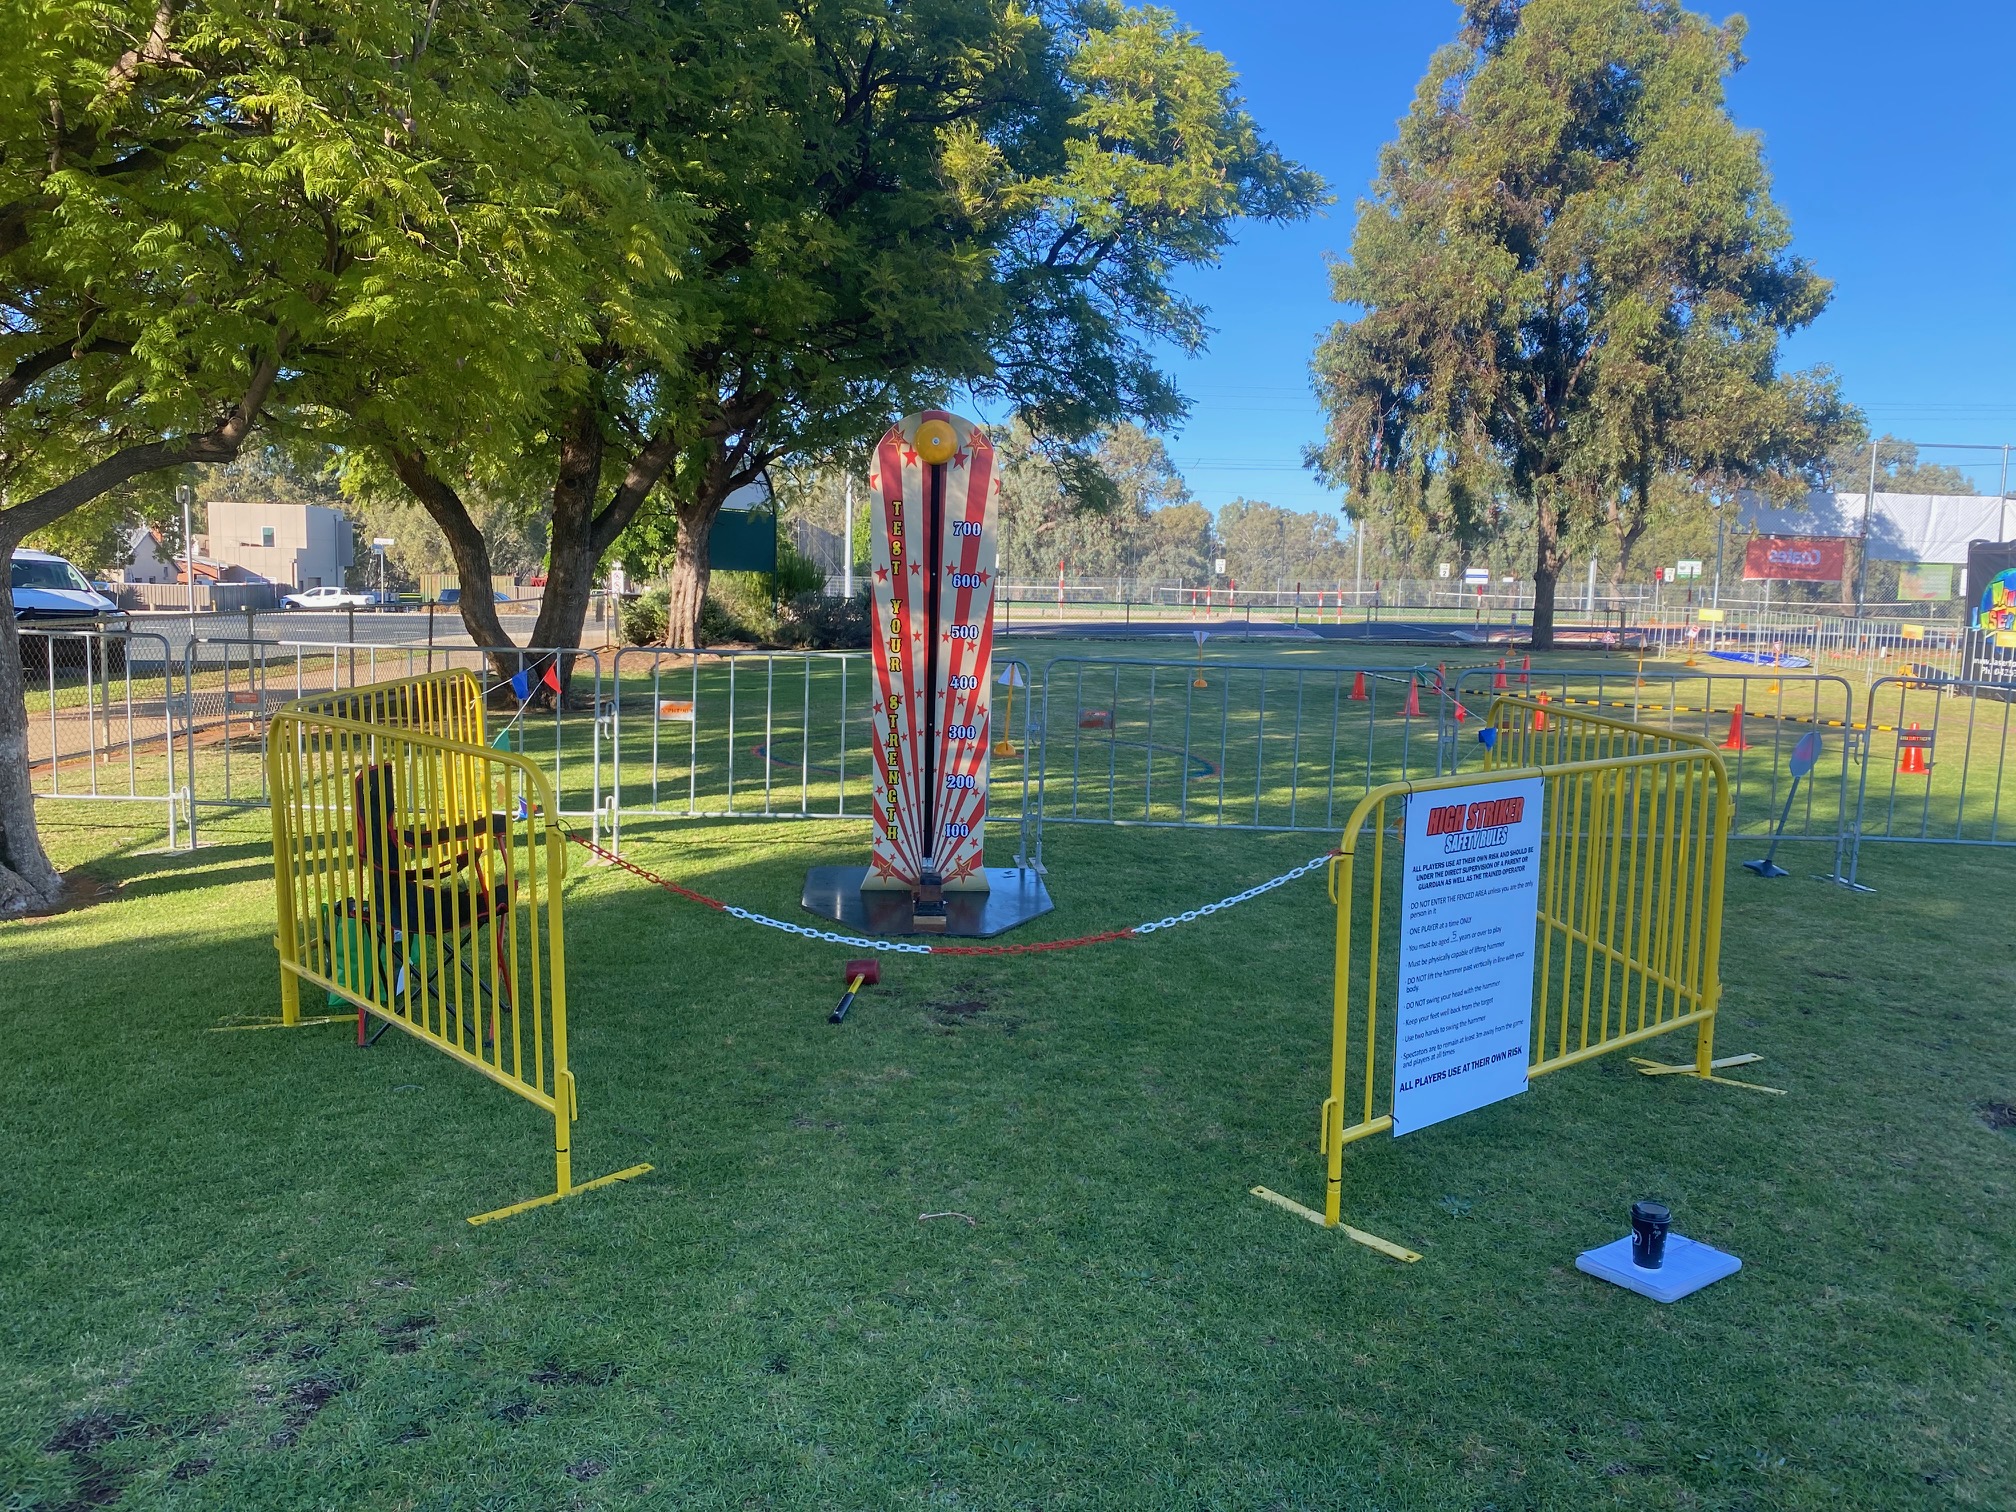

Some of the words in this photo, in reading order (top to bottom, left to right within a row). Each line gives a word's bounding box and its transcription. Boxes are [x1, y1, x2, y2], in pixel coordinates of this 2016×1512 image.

[953, 521, 982, 536] 700
[890, 501, 902, 575] TEST
[952, 574, 980, 588] 600
[890, 599, 902, 672] YOUR
[950, 625, 979, 639] 500
[950, 675, 978, 690] 400
[948, 725, 976, 740] 300
[886, 694, 900, 840] STRENGTH
[946, 774, 975, 790] 200
[1426, 804, 1466, 836] HIGH
[1466, 796, 1524, 830] STRIKER
[945, 823, 970, 838] 100
[1444, 831, 1480, 854] SAFETY
[1480, 826, 1508, 848] RULES
[1416, 872, 1434, 881] UNDER
[1445, 868, 1462, 876] DIRECT
[1462, 862, 1493, 873] SUPERVISION
[1505, 857, 1521, 866] PARENT
[1423, 862, 1444, 871] PLAYERS
[1462, 856, 1476, 864] THEIR
[1418, 880, 1444, 890] GUARDIAN
[1483, 869, 1501, 878] TRAINED
[1502, 865, 1525, 875] OPERATOR
[1420, 900, 1430, 908] NOT
[1431, 897, 1446, 906] ENTER
[1457, 892, 1474, 901] FENCED
[1410, 911, 1427, 920] person
[1410, 927, 1420, 935] ONE
[1421, 923, 1438, 932] PLAYER
[1438, 938, 1449, 946] aged
[1428, 953, 1450, 965] physically
[1451, 949, 1468, 959] capable
[1487, 941, 1505, 950] hammer
[1419, 1016, 1429, 1024] your
[1440, 1008, 1449, 1016] well
[1450, 1006, 1461, 1014] back
[1481, 998, 1493, 1006] target
[1403, 1060, 1412, 1068] and
[1413, 1056, 1430, 1066] players
[1443, 1049, 1455, 1057] times
[1399, 1081, 1413, 1092] ALL
[1415, 1071, 1446, 1088] PLAYERS
[1448, 1066, 1461, 1077] USE
[1462, 1063, 1470, 1073] AT
[1471, 1057, 1490, 1069] THEIR
[1492, 1051, 1507, 1063] OWN
[1508, 1046, 1522, 1058] RISK
